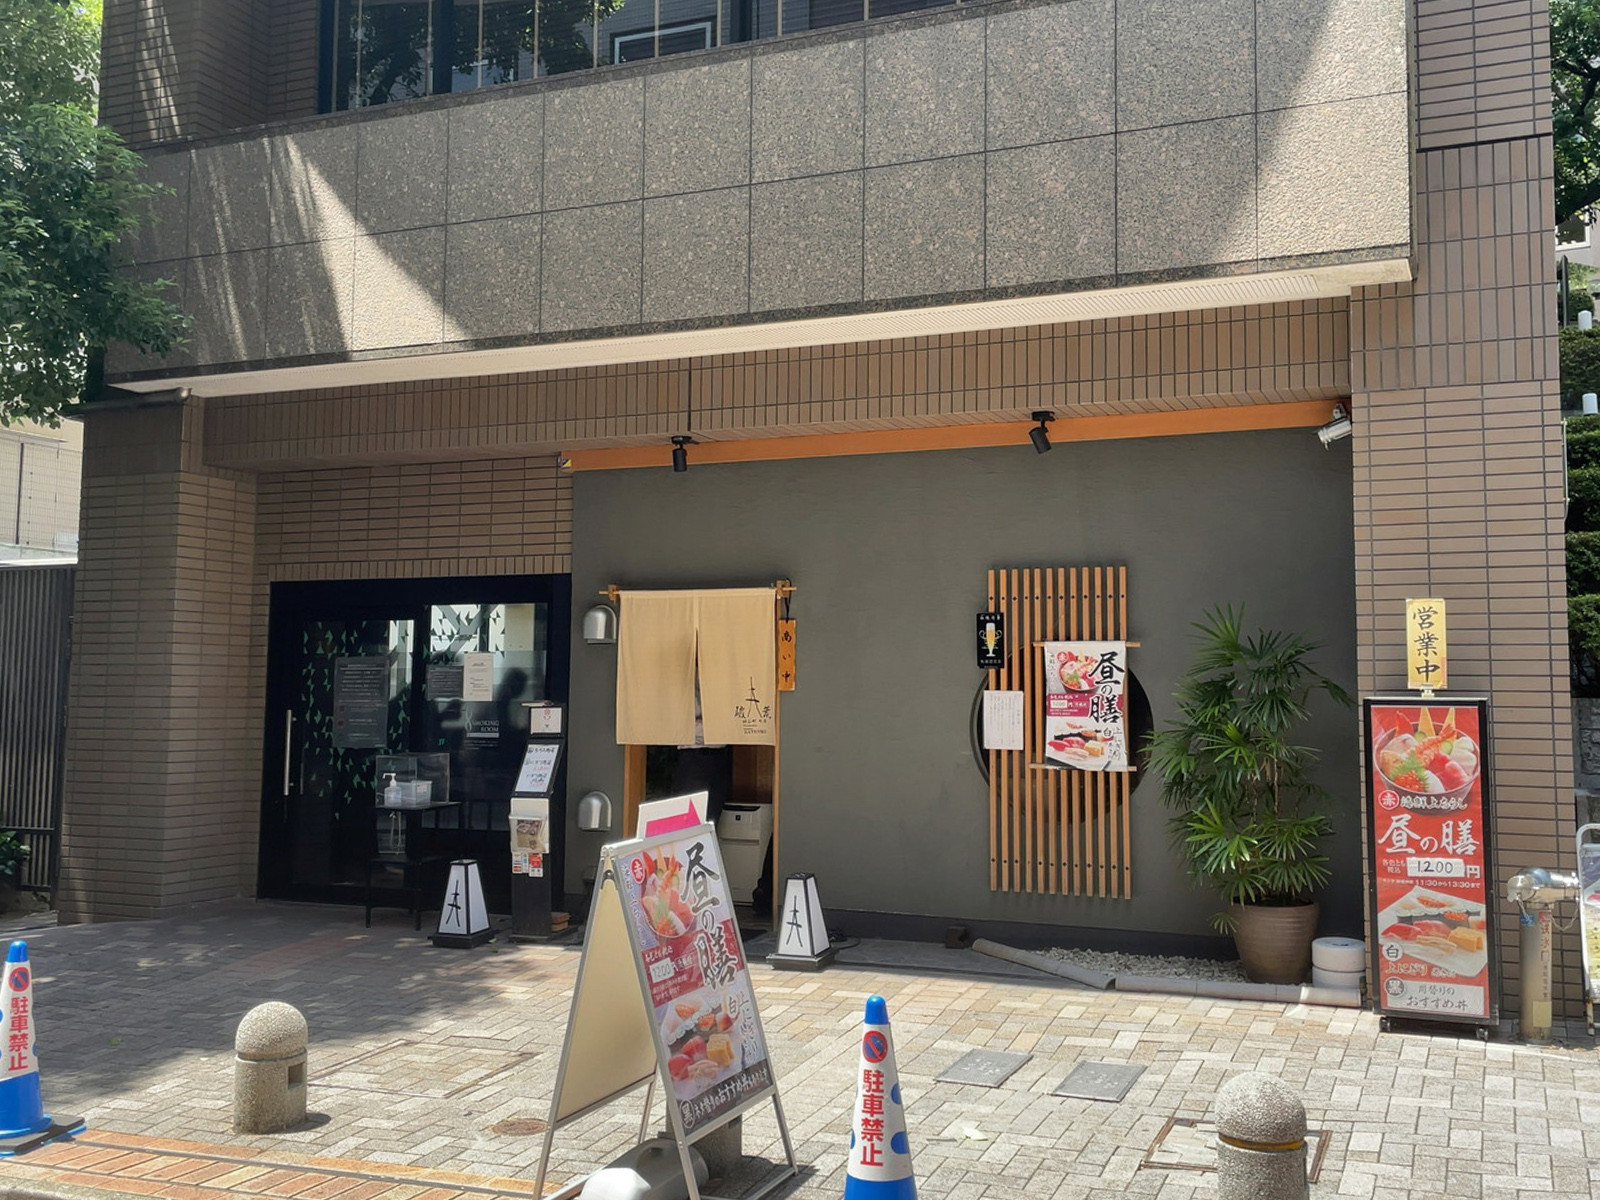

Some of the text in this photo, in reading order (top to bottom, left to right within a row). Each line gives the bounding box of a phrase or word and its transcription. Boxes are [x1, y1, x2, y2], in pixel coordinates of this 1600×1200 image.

[1413, 606, 1440, 682] 営業中
[1089, 651, 1125, 724] 昼の膳
[1103, 728, 1111, 737] 白
[1378, 814, 1480, 855] 昼の膳
[1466, 865, 1480, 878] 円
[680, 842, 738, 990] 昼の膳
[1386, 945, 1399, 958] 白
[729, 996, 737, 1014] 白
[1406, 995, 1468, 1012] おすすめ丼
[8, 997, 28, 1071] 駐車禁止
[860, 1069, 884, 1167] 駐車禁止
